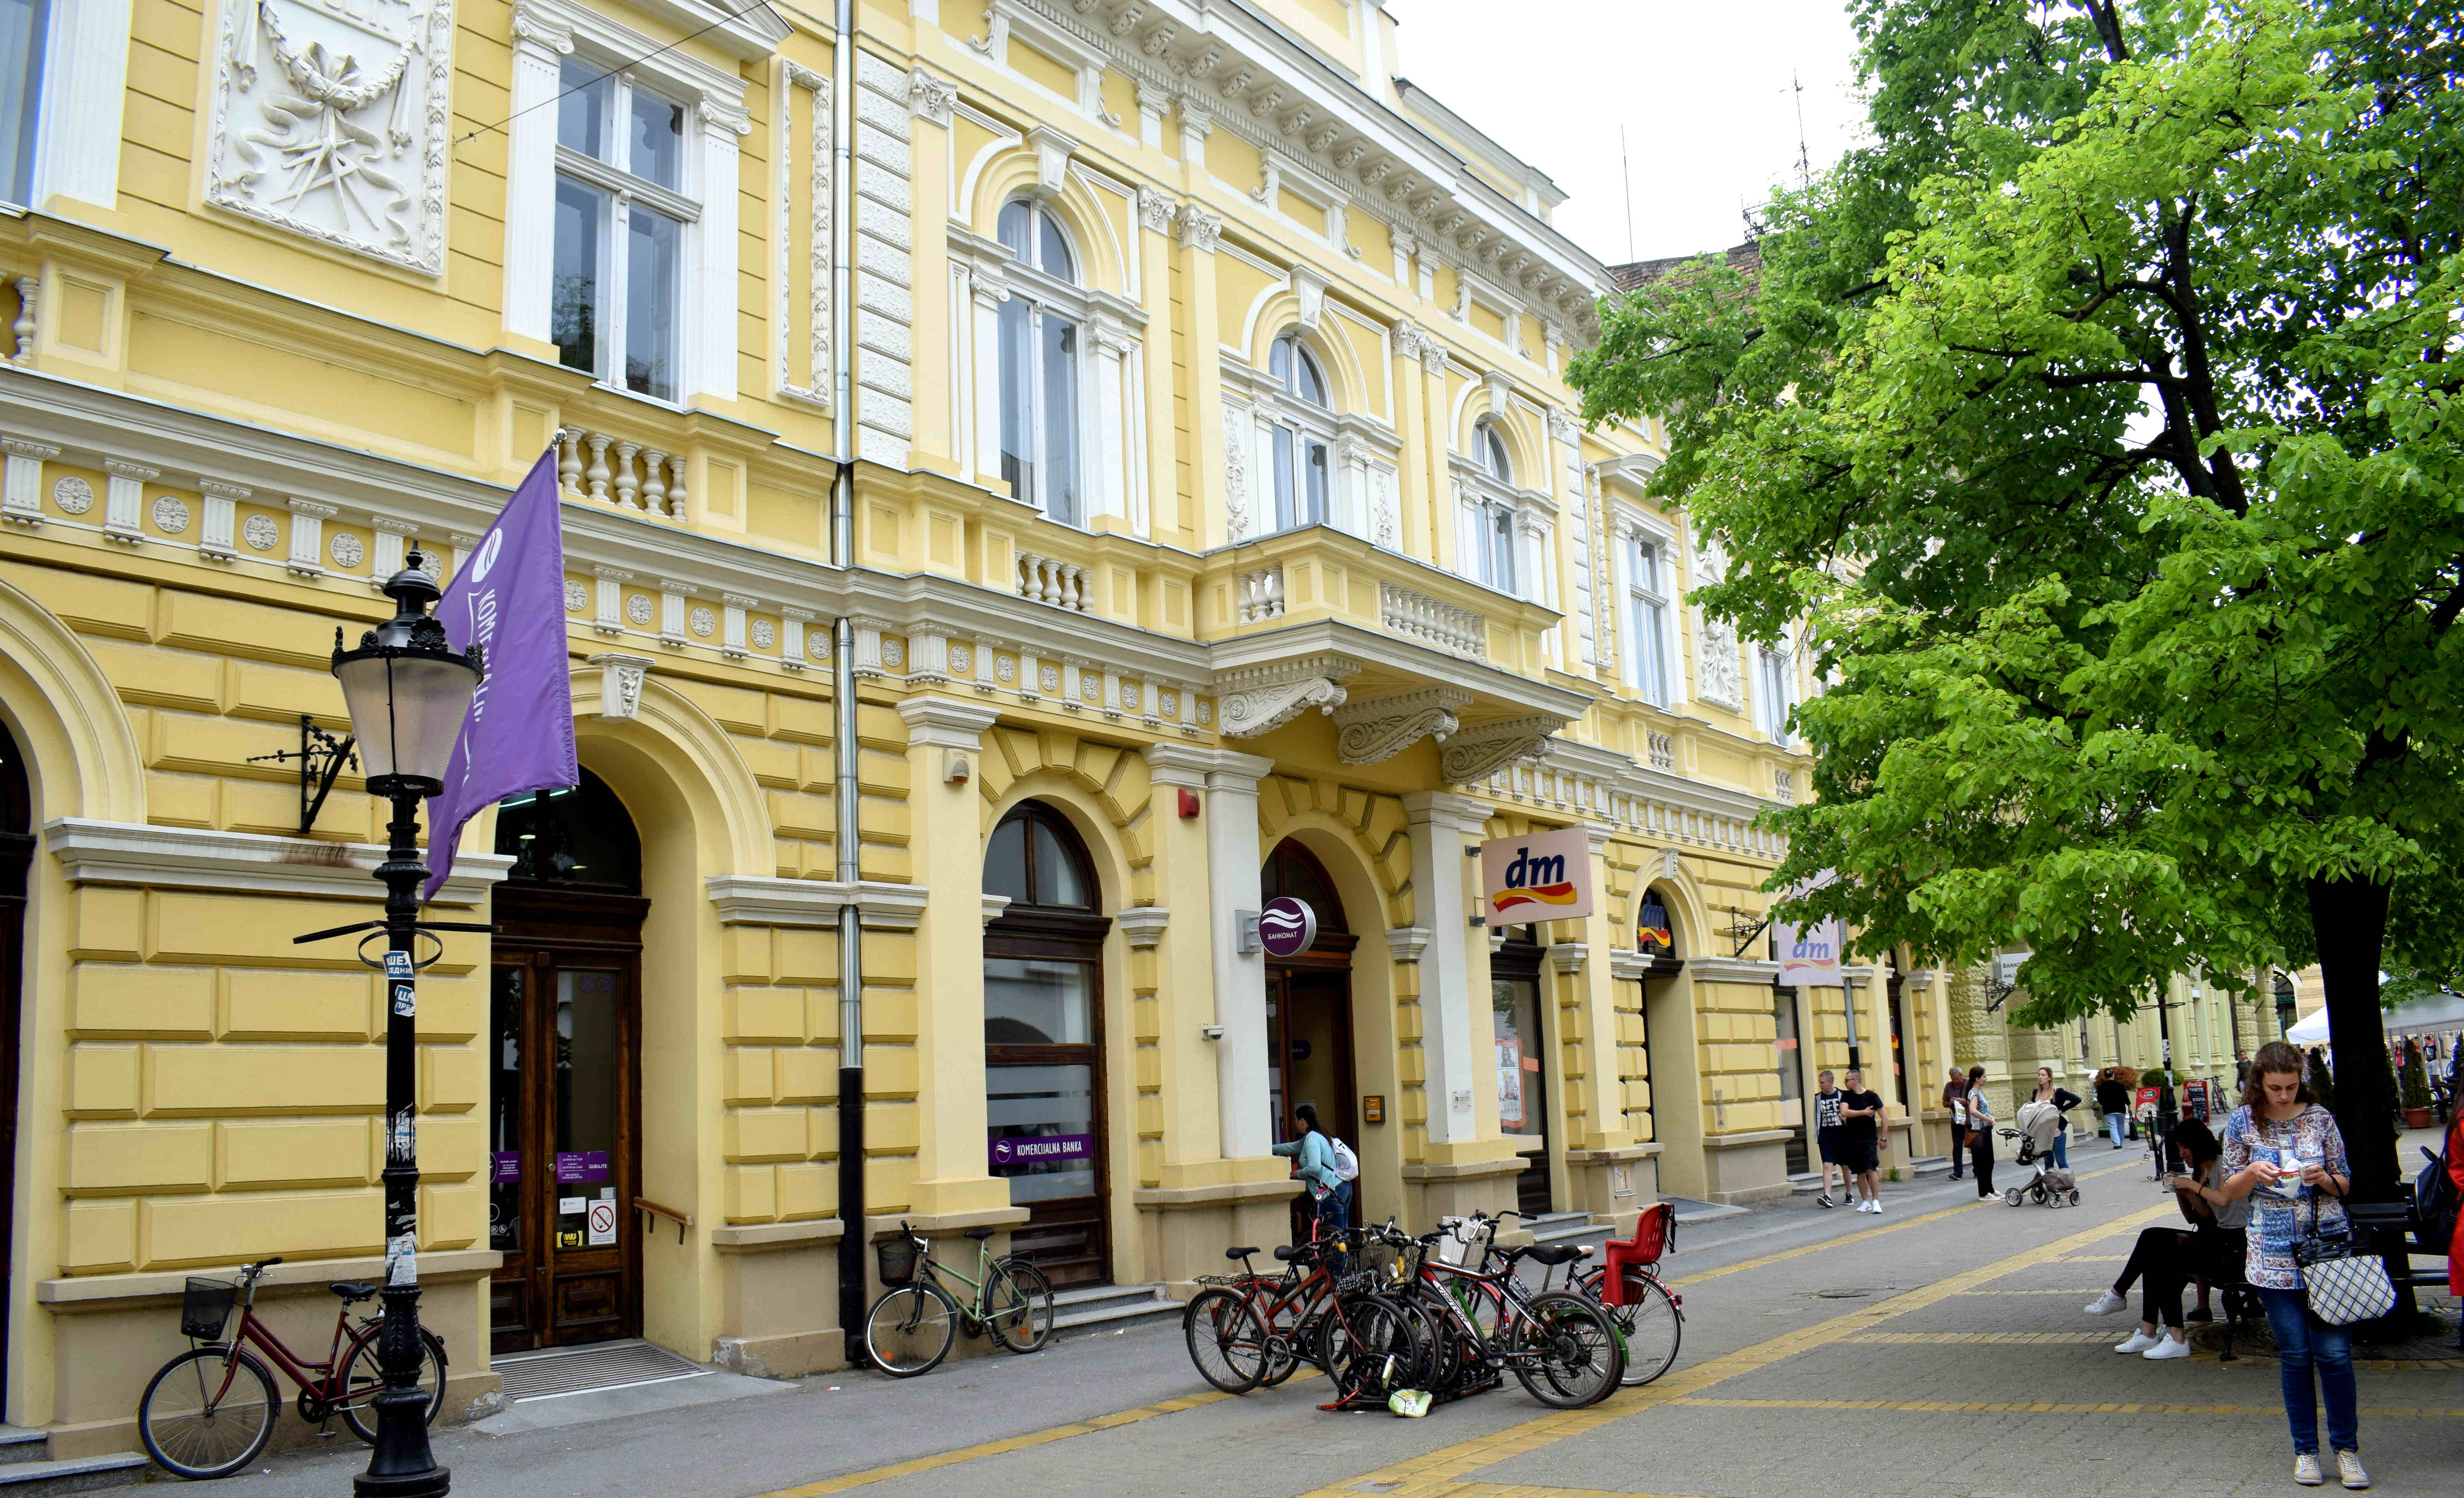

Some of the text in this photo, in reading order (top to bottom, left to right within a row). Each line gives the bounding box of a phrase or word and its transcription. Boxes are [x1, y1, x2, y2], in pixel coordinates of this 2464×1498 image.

[1506, 847, 1565, 889] dm
[1268, 931, 1298, 940] БАНКОМАТ
[1792, 936, 1829, 959] dm
[1017, 1141, 1082, 1156] KOMERCIJALNA BANKA
[1437, 1284, 1468, 1323] VISITOR
